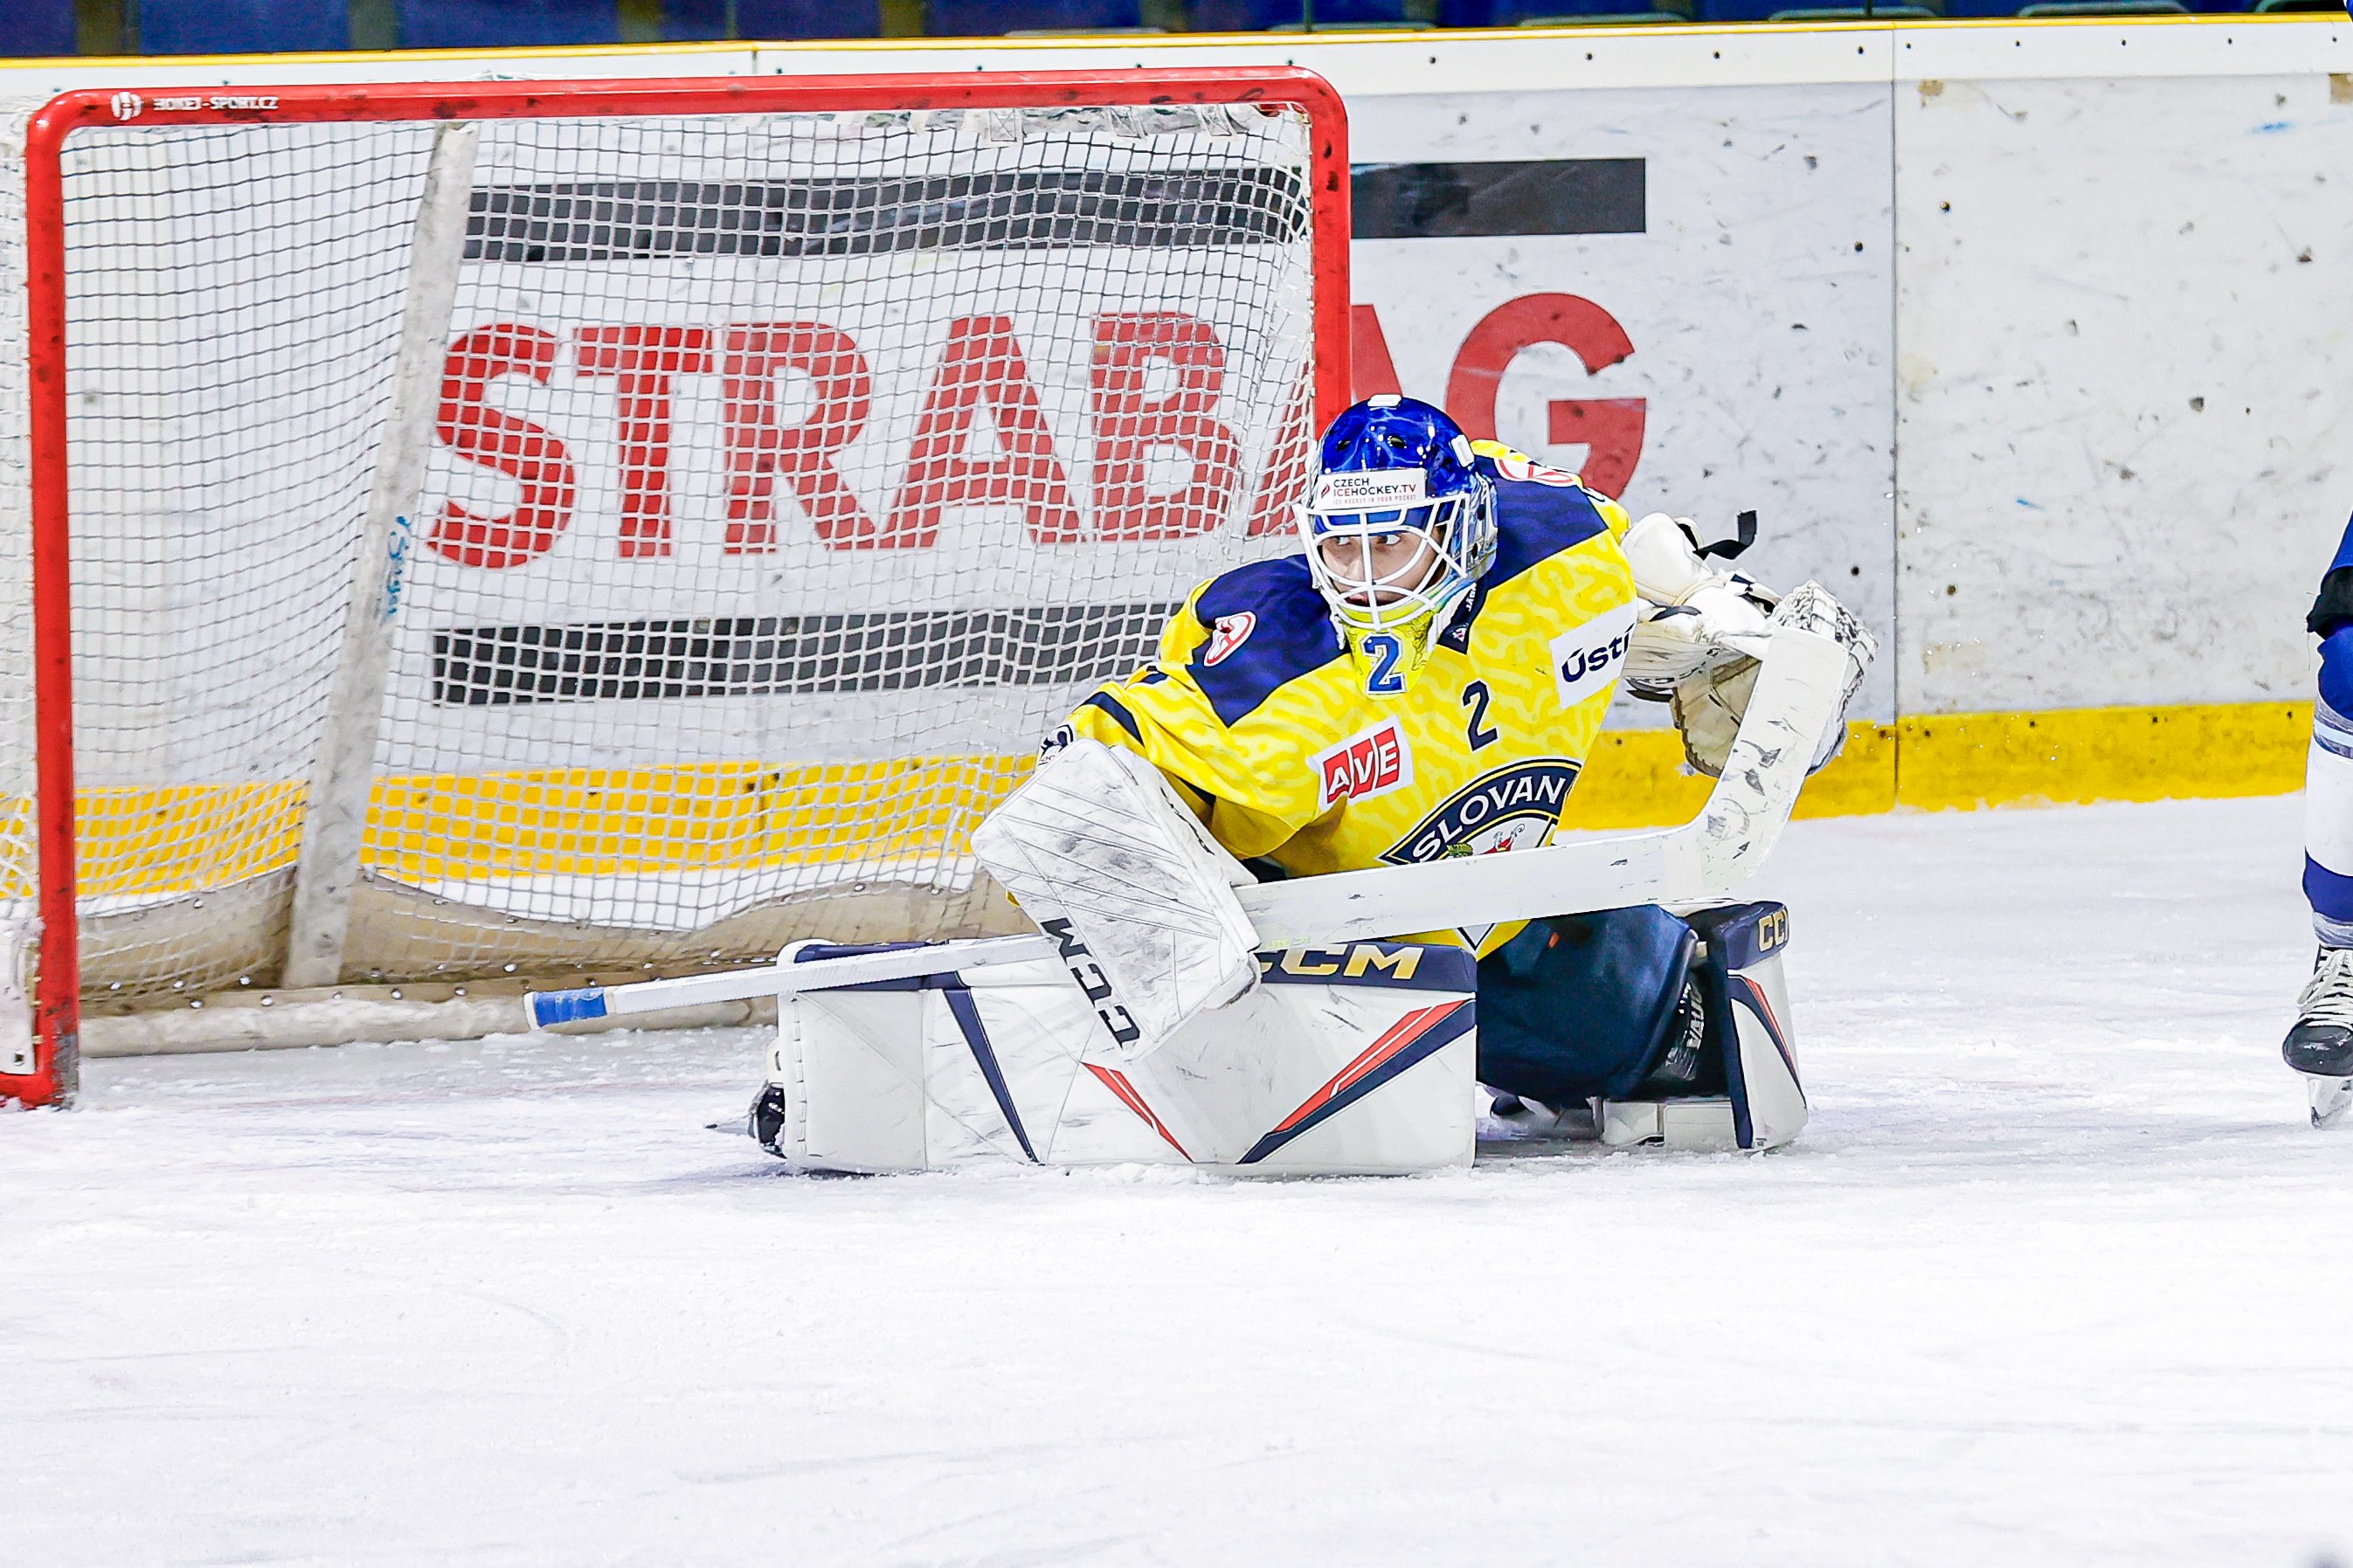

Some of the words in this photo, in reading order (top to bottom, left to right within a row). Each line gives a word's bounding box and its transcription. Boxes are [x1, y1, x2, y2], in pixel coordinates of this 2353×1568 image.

[1333, 478, 1369, 487] CZECH
[1333, 484, 1416, 497] ICEHOCKEY.TV
[1360, 632, 1407, 694] 2
[1561, 621, 1635, 682] Ústí
[1462, 680, 1498, 752] 2
[1327, 740, 1398, 795] AVE
[1412, 775, 1566, 863] SLOVAN
[1758, 909, 1789, 952] CC
[1040, 917, 1140, 1051] CCM
[1260, 943, 1424, 980] CM
